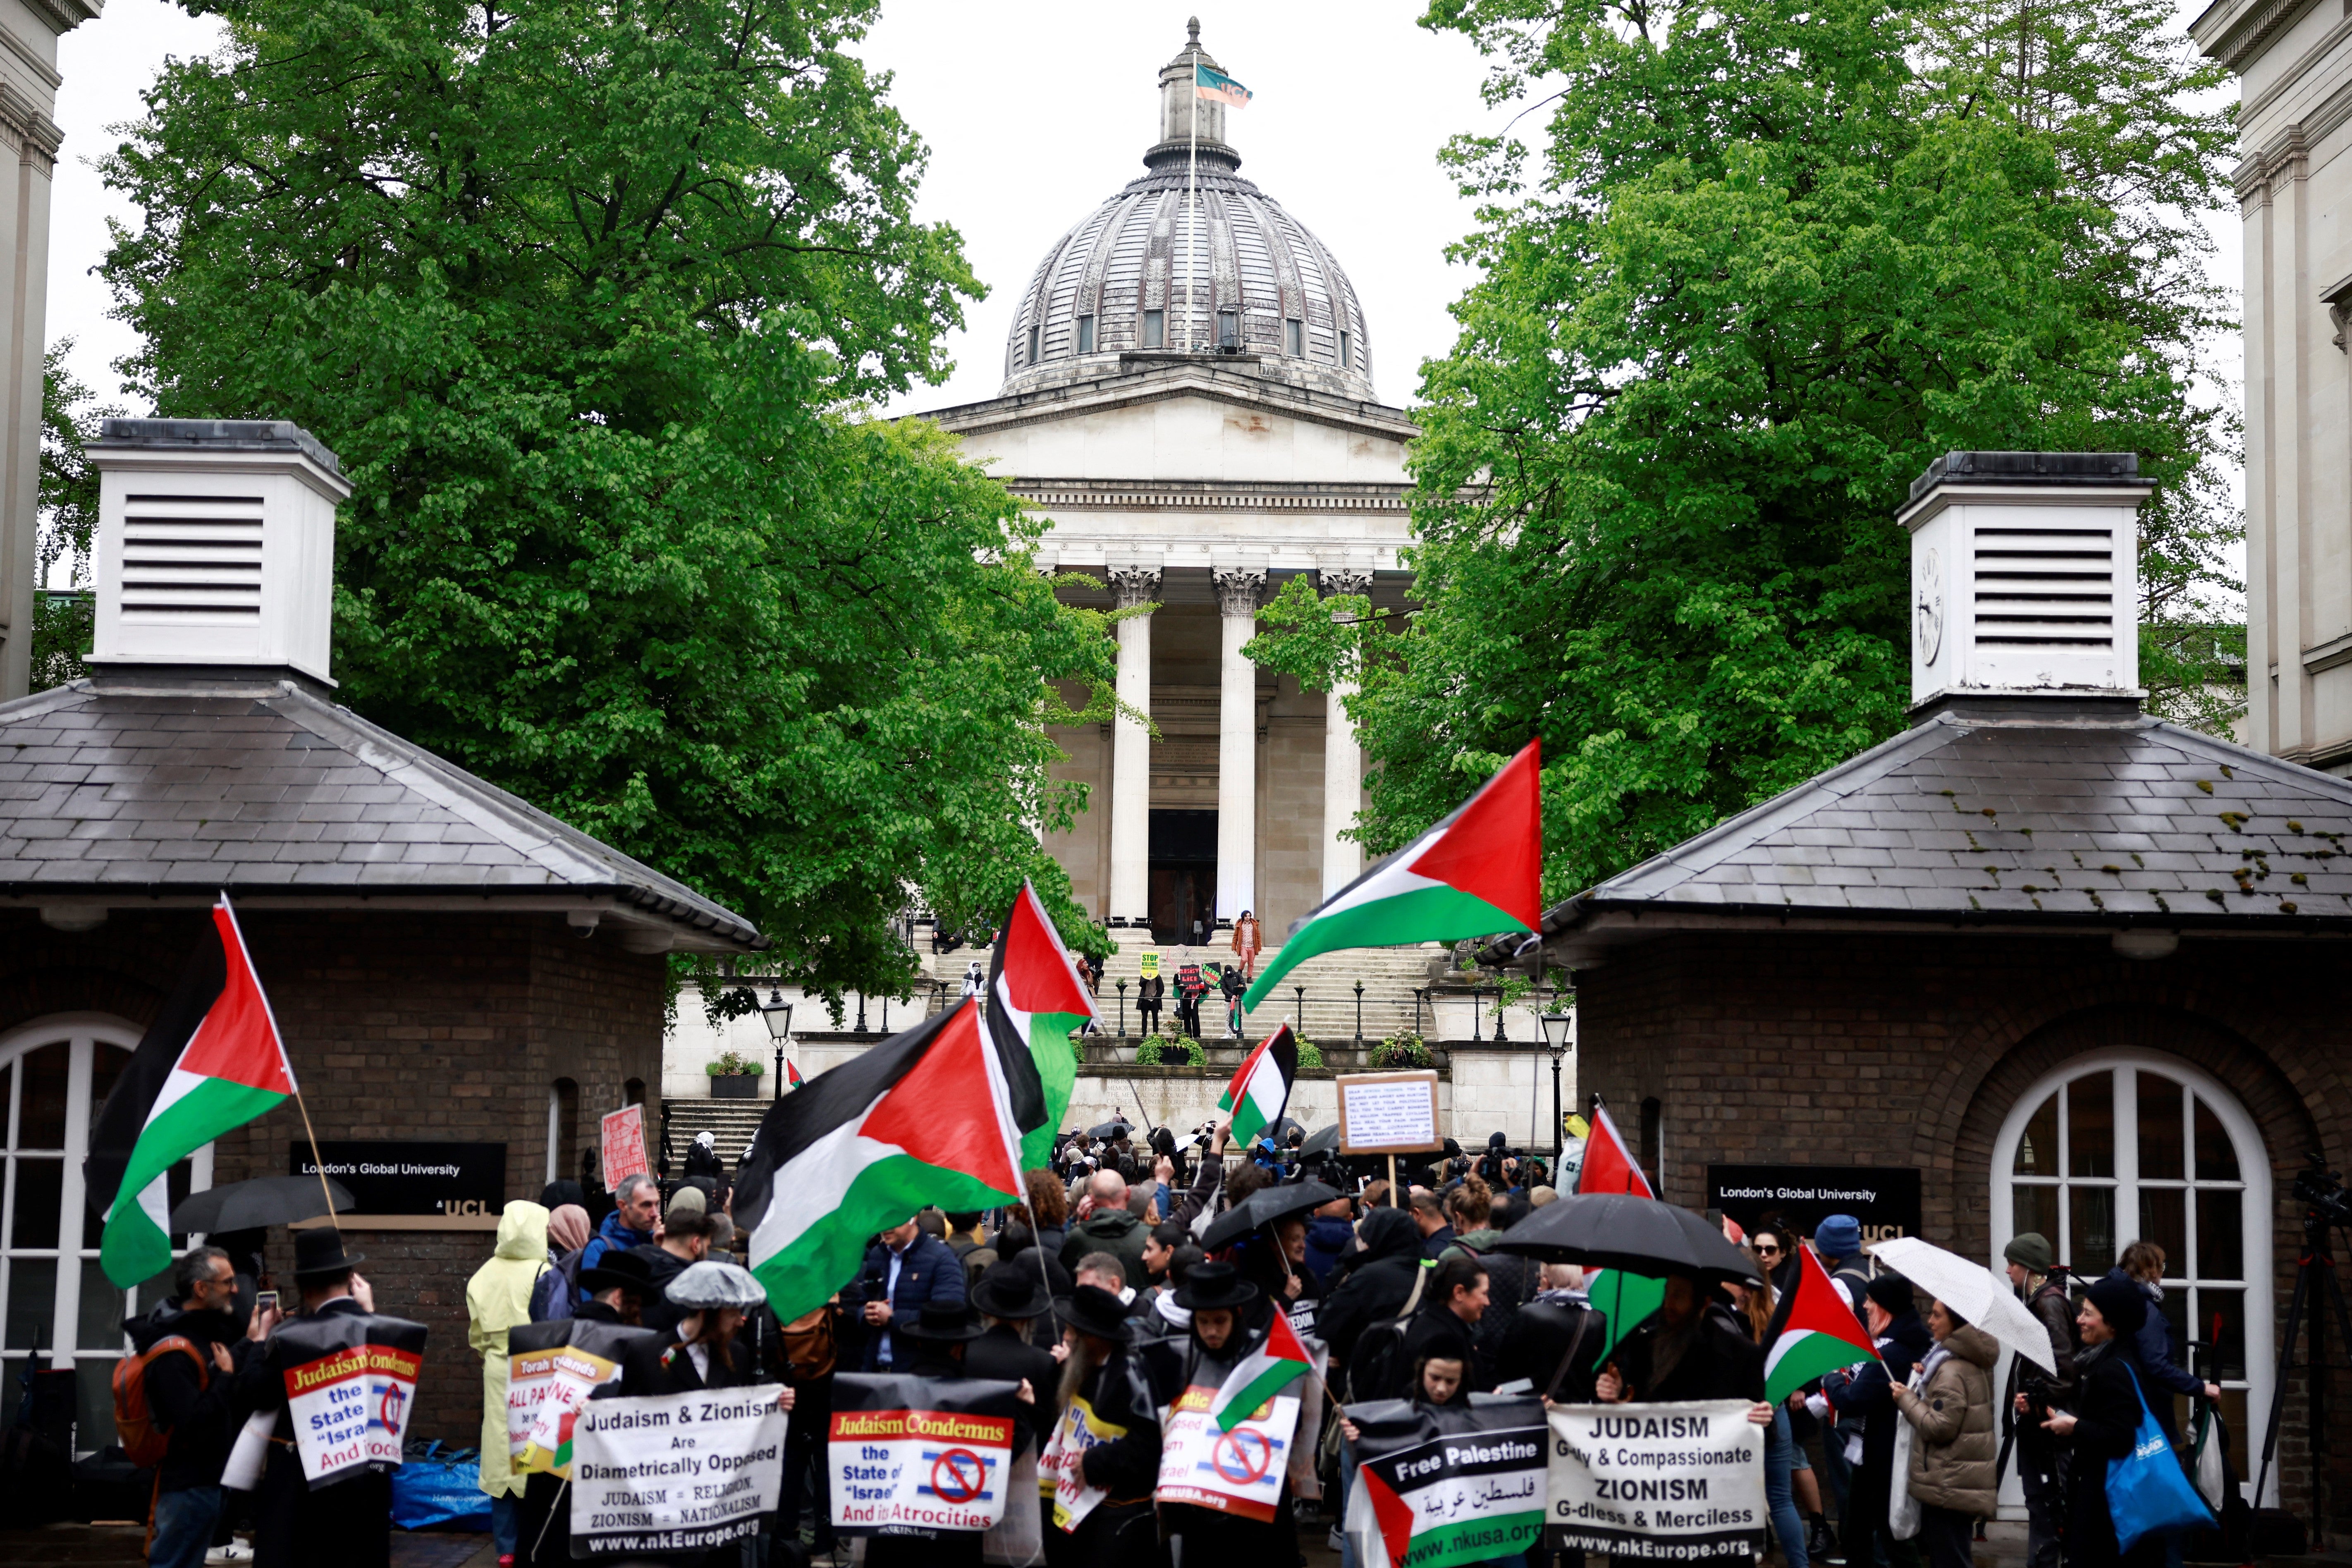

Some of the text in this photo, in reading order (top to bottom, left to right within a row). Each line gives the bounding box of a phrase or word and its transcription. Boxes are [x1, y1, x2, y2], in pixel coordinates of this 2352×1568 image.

[1221, 83, 1251, 100] UCL
[302, 1163, 460, 1177] London's Global University
[1720, 1187, 1876, 1202] London's Global University
[445, 1200, 492, 1216] UCL
[294, 1355, 368, 1391] Judaism
[521, 1358, 550, 1374] Torah
[328, 1386, 362, 1404] the
[509, 1390, 526, 1409] ALL
[311, 1404, 363, 1430] State
[584, 1399, 778, 1432] Judaism & Zionism
[836, 1414, 1005, 1442] Judaism Condemns
[1589, 1417, 1709, 1439] JUDAISM
[672, 1437, 696, 1449] Are
[861, 1446, 889, 1461] the
[321, 1443, 359, 1470] And
[581, 1445, 777, 1480] Diametrically Opposed
[1395, 1440, 1537, 1482] Free Palestine
[1599, 1448, 1610, 1465] &
[1617, 1447, 1752, 1470] Compassionate
[843, 1465, 886, 1481] State
[601, 1490, 667, 1506] JUDAISM
[1424, 1477, 1535, 1518] فلسطين عربية
[1595, 1479, 1708, 1501] ZIONISM
[591, 1513, 653, 1528] ZIONISM
[680, 1495, 761, 1524] NATIONALISM
[843, 1505, 874, 1522] And
[891, 1503, 992, 1529] Atrocities
[1556, 1500, 1753, 1528] G-dless & Merciless
[588, 1519, 760, 1553] www.nkEurope.org
[1563, 1534, 1750, 1561] www.nkEurope.org
